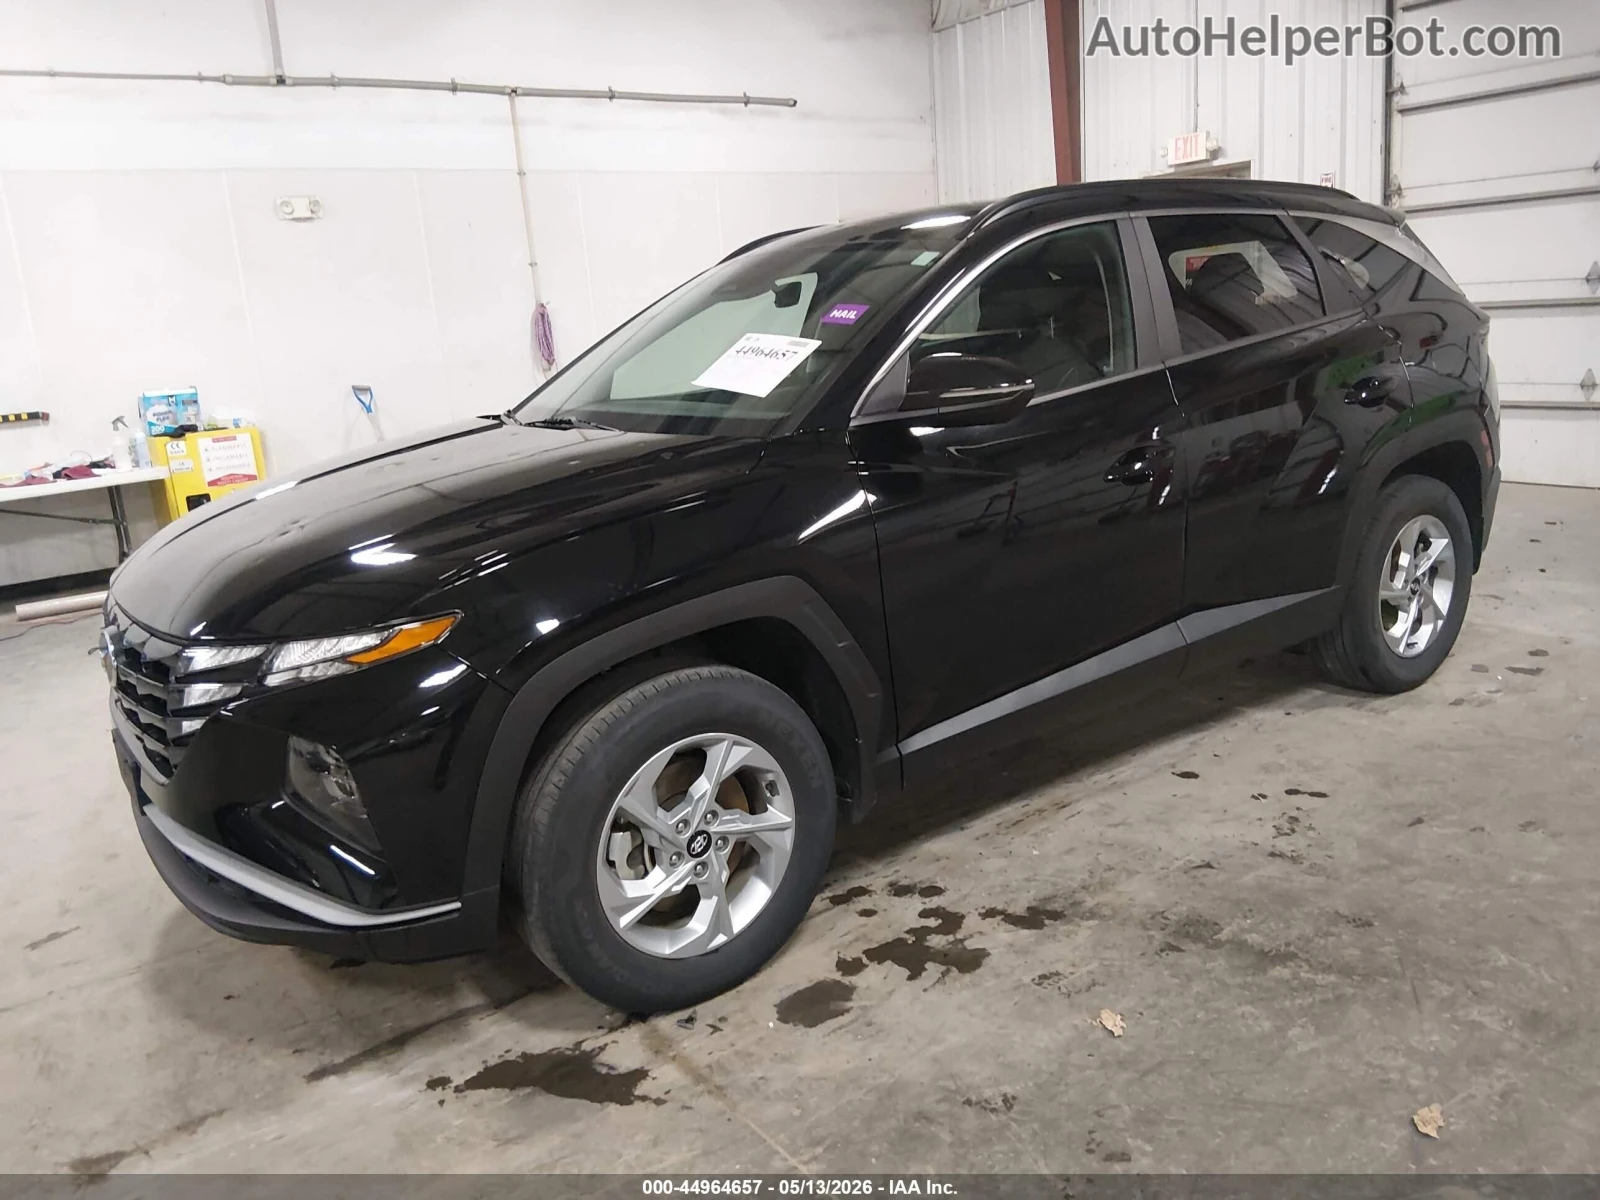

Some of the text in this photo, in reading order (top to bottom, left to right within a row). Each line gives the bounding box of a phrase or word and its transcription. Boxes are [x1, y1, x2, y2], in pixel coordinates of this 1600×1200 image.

[1175, 134, 1200, 160] EXIT
[830, 309, 857, 319] HAIL
[735, 345, 799, 362] 44964657
[151, 425, 165, 434] 200
